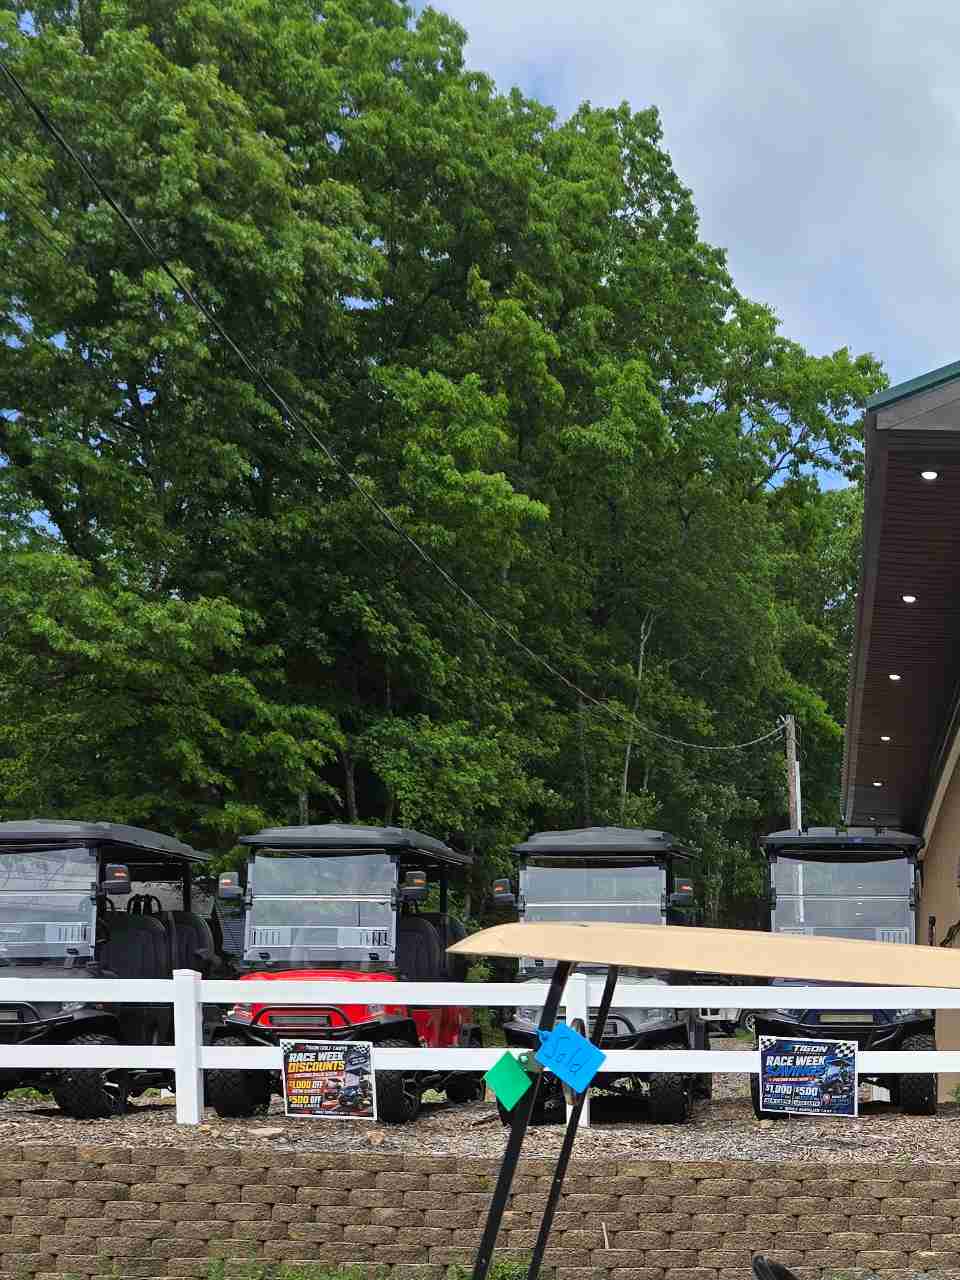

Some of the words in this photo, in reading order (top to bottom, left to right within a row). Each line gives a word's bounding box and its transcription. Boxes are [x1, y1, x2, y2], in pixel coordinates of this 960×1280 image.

[288, 1053, 316, 1063] RACE
[318, 1052, 345, 1061] WEEK
[766, 1055, 795, 1066] RACE
[796, 1055, 826, 1066] WEEK
[287, 1061, 346, 1073] DISCOUNTS
